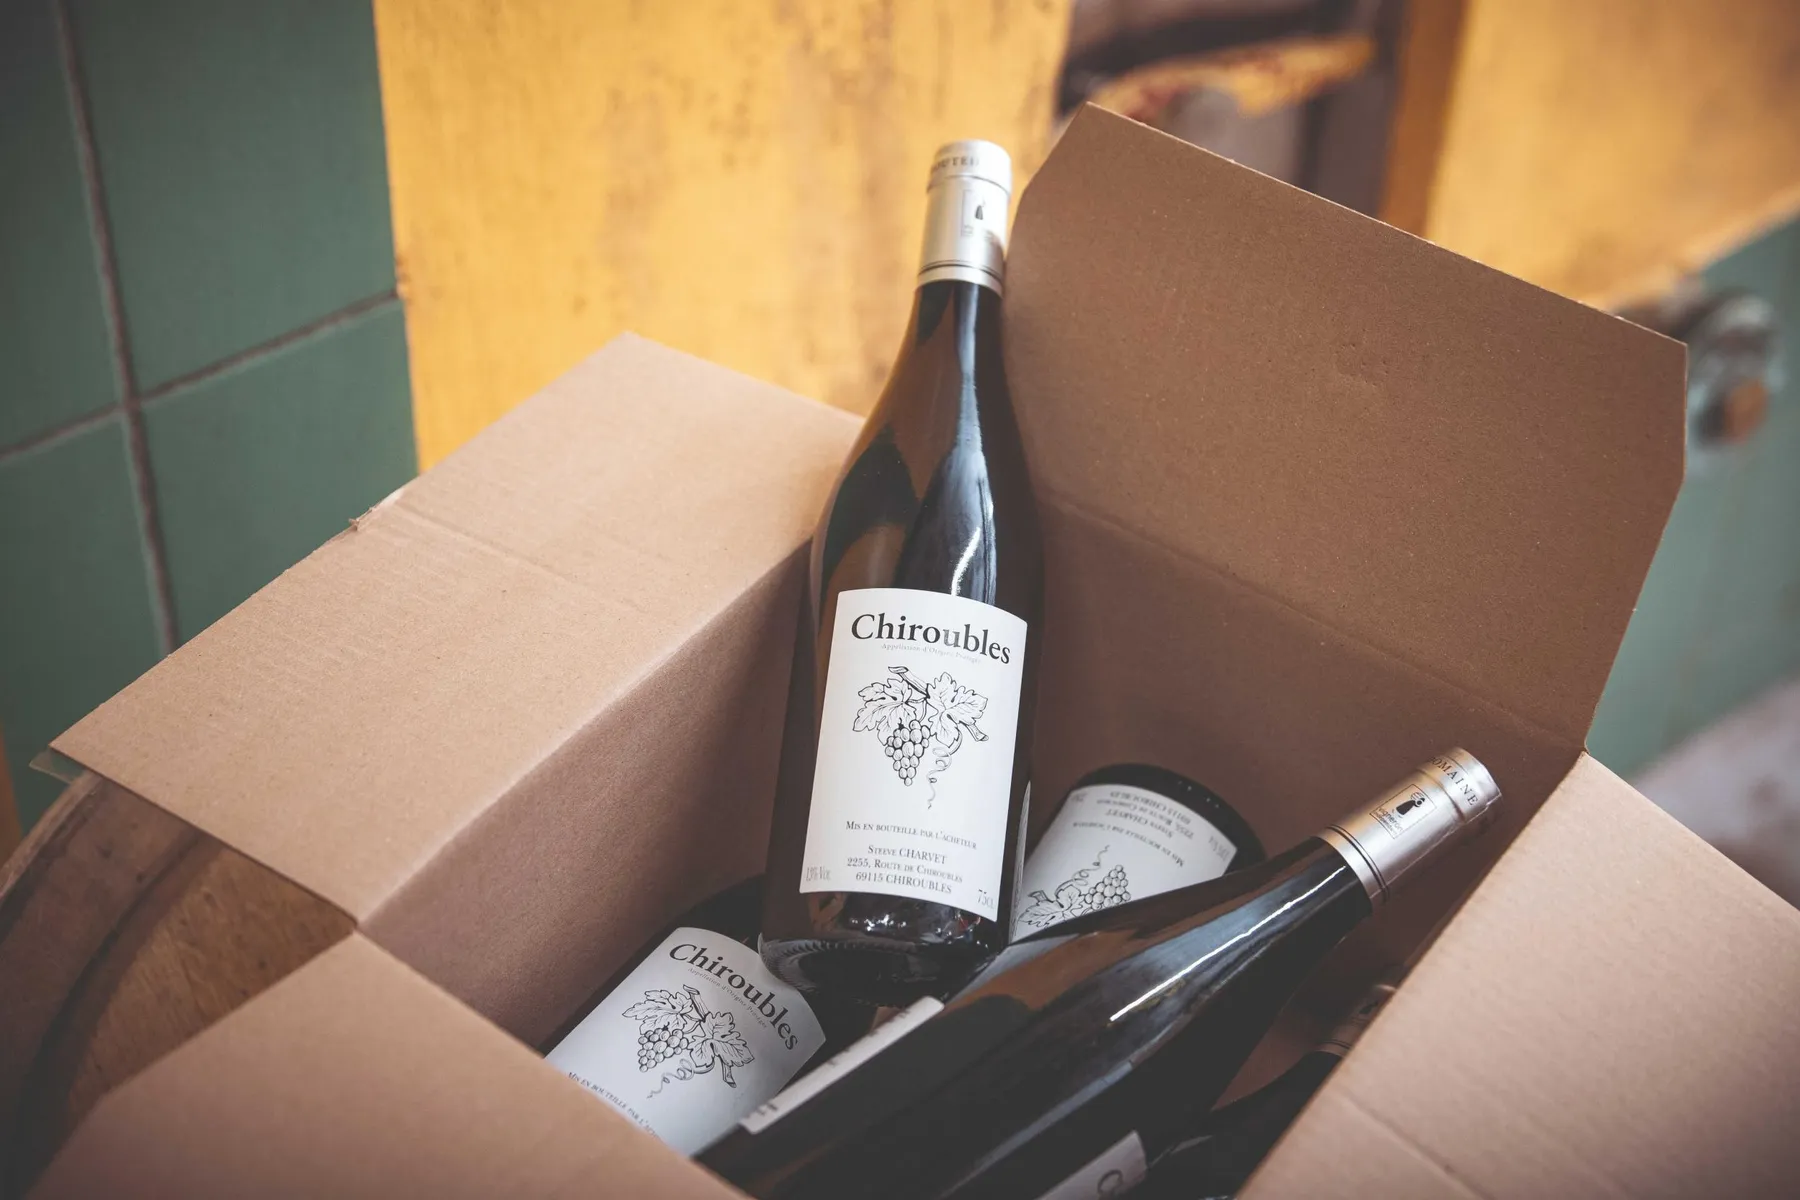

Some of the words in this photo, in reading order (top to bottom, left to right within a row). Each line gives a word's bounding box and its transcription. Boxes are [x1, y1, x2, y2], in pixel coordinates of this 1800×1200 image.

[851, 612, 1011, 664] Chiroubles
[899, 847, 948, 865] CHARVET
[846, 856, 872, 869] 2255,
[916, 863, 963, 884] CHIROUBLES
[855, 871, 884, 883] 69115
[885, 872, 952, 894] CHIROUBLES
[687, 966, 721, 987] Appellation
[669, 943, 798, 1050] Chiroubles
